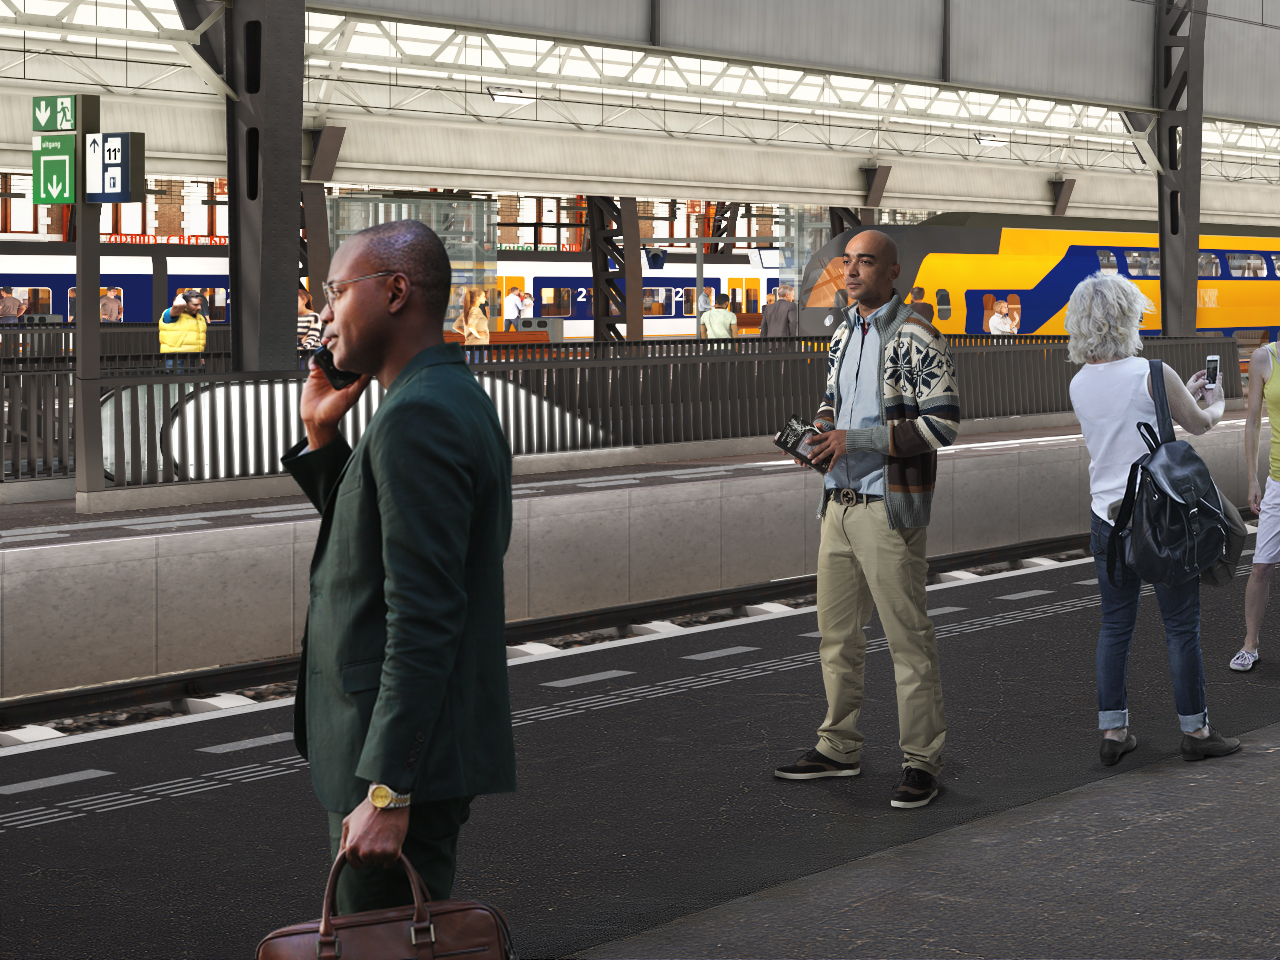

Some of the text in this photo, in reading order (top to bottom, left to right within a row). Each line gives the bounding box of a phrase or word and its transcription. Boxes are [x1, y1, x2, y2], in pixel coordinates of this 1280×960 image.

[42, 141, 61, 149] uitgang
[577, 287, 587, 302] 2
[675, 287, 684, 301] 2
